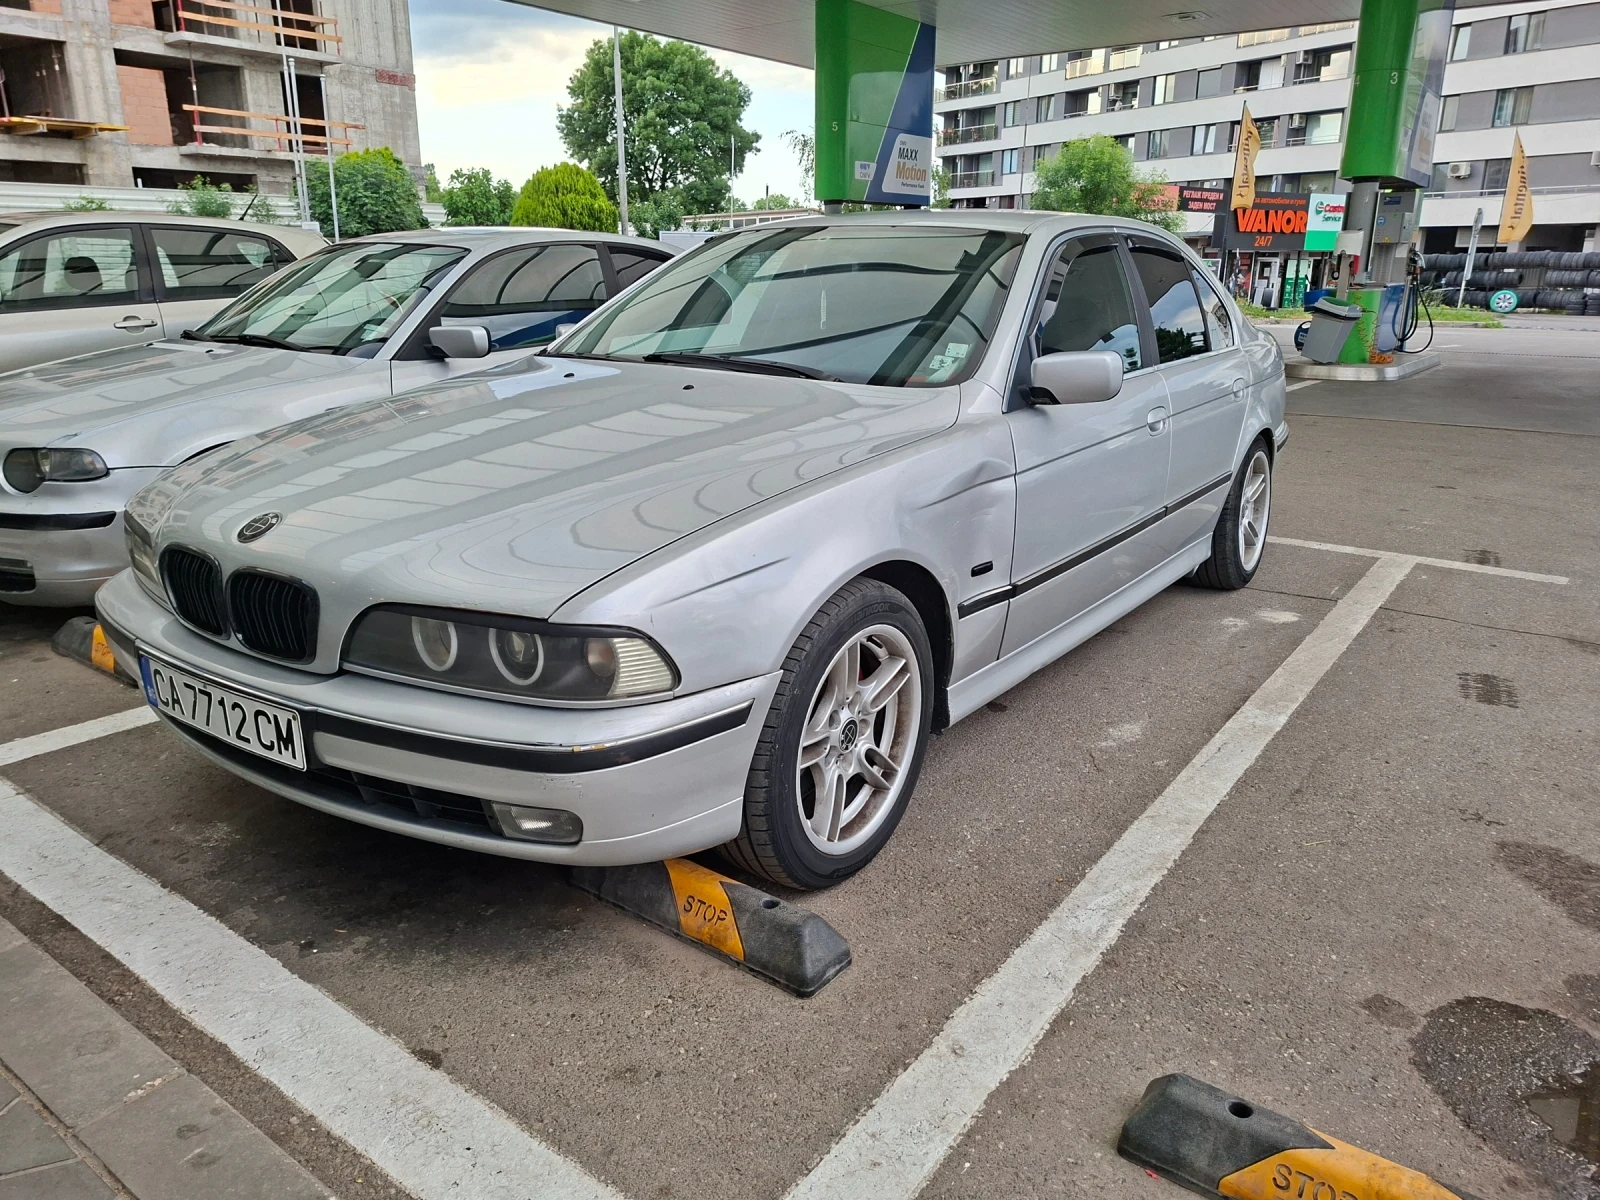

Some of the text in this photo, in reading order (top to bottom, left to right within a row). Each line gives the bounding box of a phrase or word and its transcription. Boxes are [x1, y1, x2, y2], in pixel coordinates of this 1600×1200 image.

[1390, 71, 1399, 85] 3
[831, 121, 839, 131] 5
[897, 147, 919, 161] MAXX
[895, 161, 927, 182] Motion
[1182, 189, 1198, 200] РЕГЛАЖ
[1198, 191, 1218, 201] ПРЕДЕН
[1188, 200, 1217, 211] ЗАДЕН МОСТ
[1322, 213, 1342, 222] Service
[1254, 235, 1273, 247] 24/7
[683, 894, 728, 926] STOP
